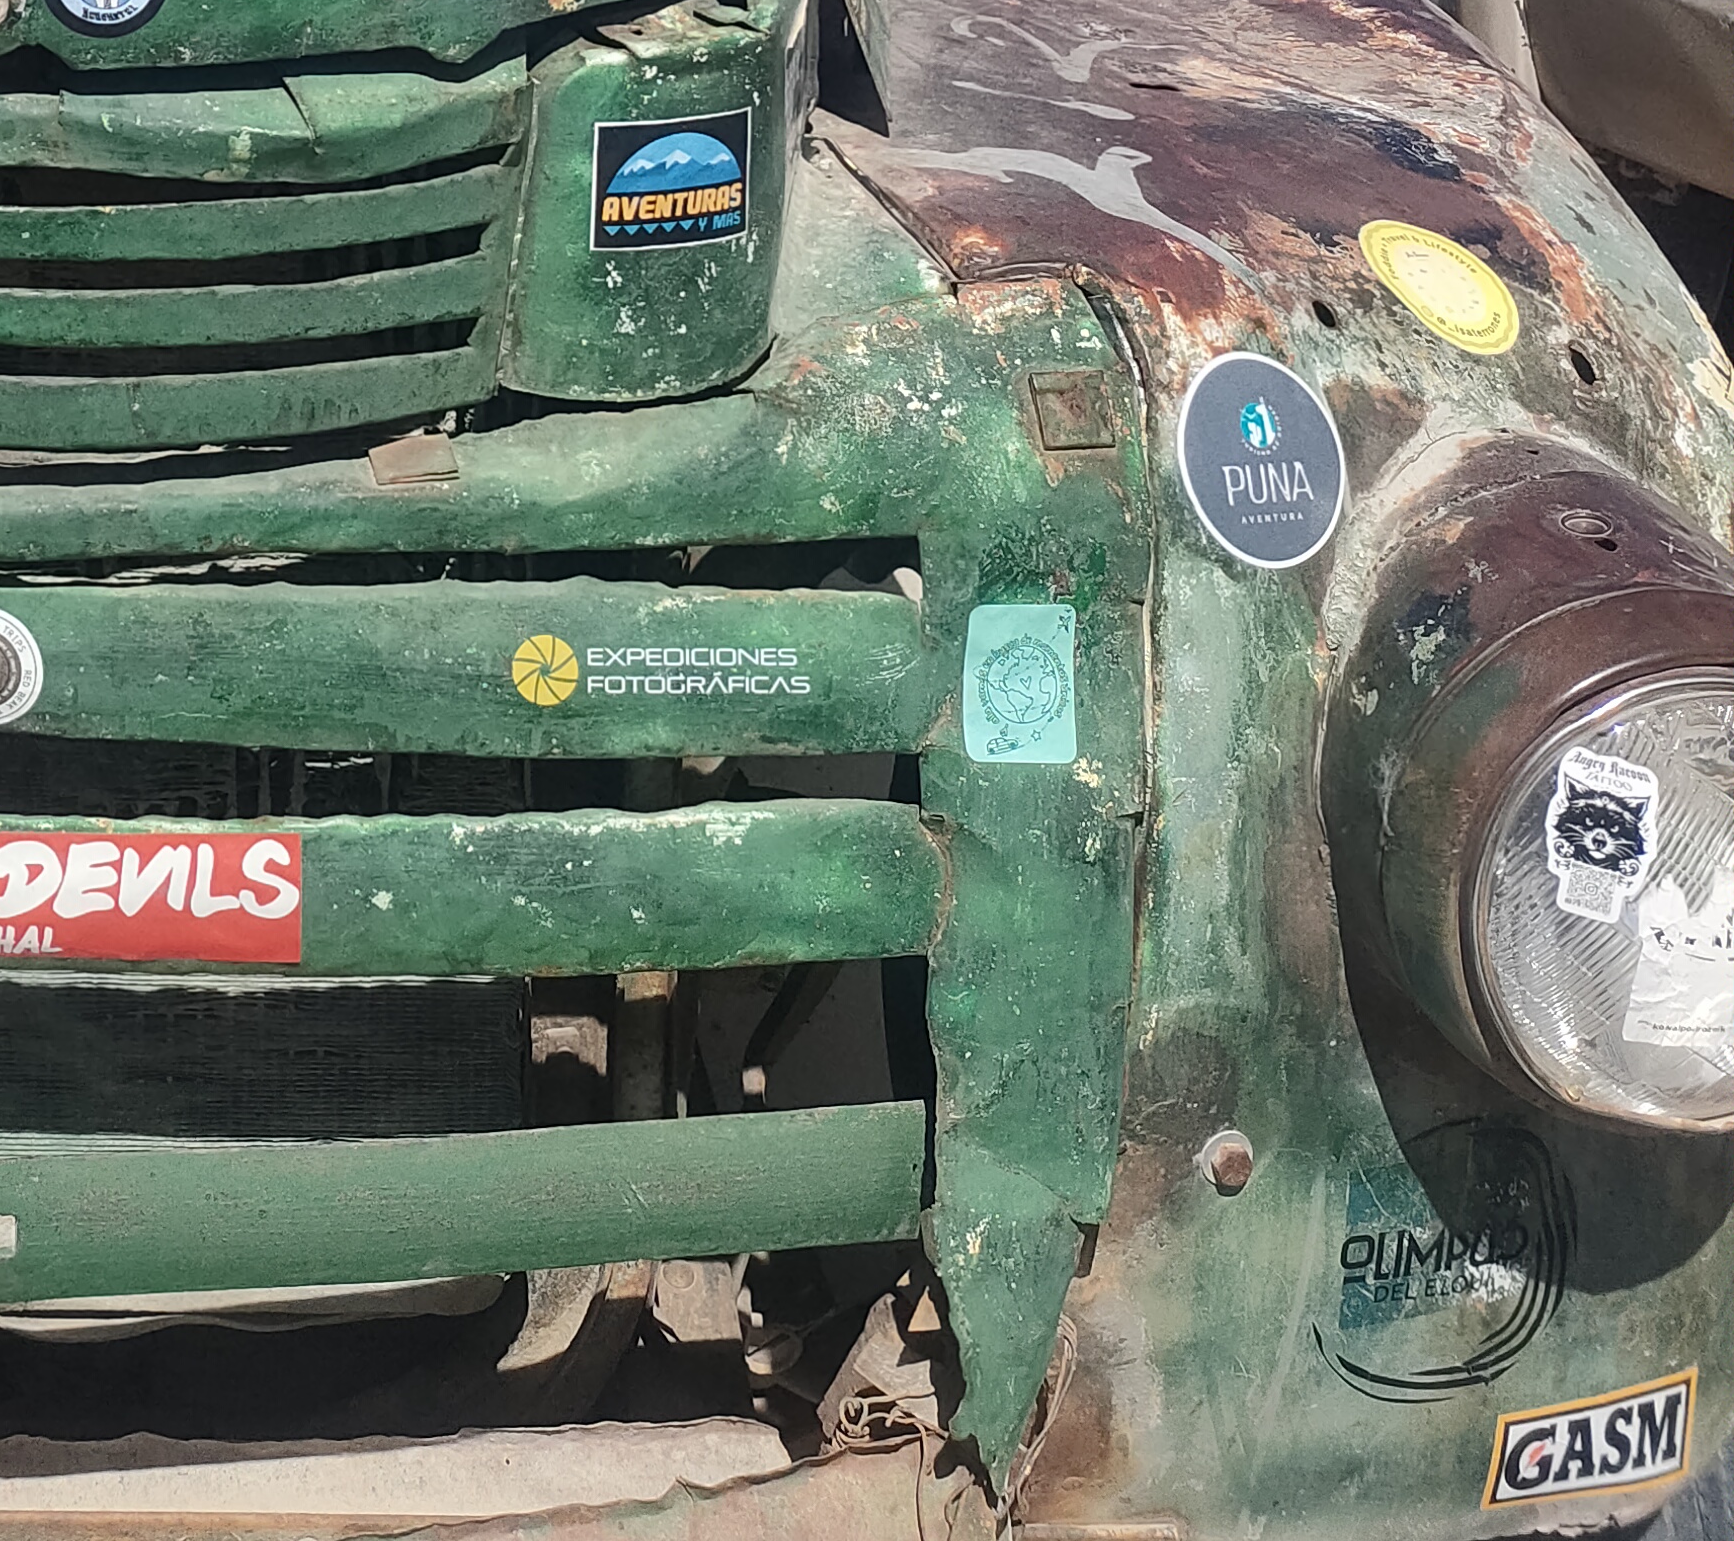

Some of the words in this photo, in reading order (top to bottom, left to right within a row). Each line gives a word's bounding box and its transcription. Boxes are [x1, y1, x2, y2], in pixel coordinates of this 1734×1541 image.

[601, 182, 743, 222] AVENTURAS
[698, 218, 708, 232] Y
[1381, 233, 1411, 244] Travel
[1423, 238, 1478, 274] Lifestyle
[1222, 460, 1315, 507] PUNA
[1240, 510, 1304, 525] AVENTURA
[2, 625, 26, 653] TRIPS
[587, 647, 798, 666] EXPEDICIONES
[22, 669, 33, 688] RED
[587, 670, 811, 695] FOTOGRÁFICAS
[7, 691, 27, 710] BEAK
[1571, 752, 1607, 773] Angry
[1609, 760, 1652, 785] Racoon
[1585, 773, 1633, 793] TATTOO
[1373, 1281, 1416, 1303] DEL
[1424, 1275, 1496, 1298] ELQUI
[1504, 1391, 1683, 1491] GASM
